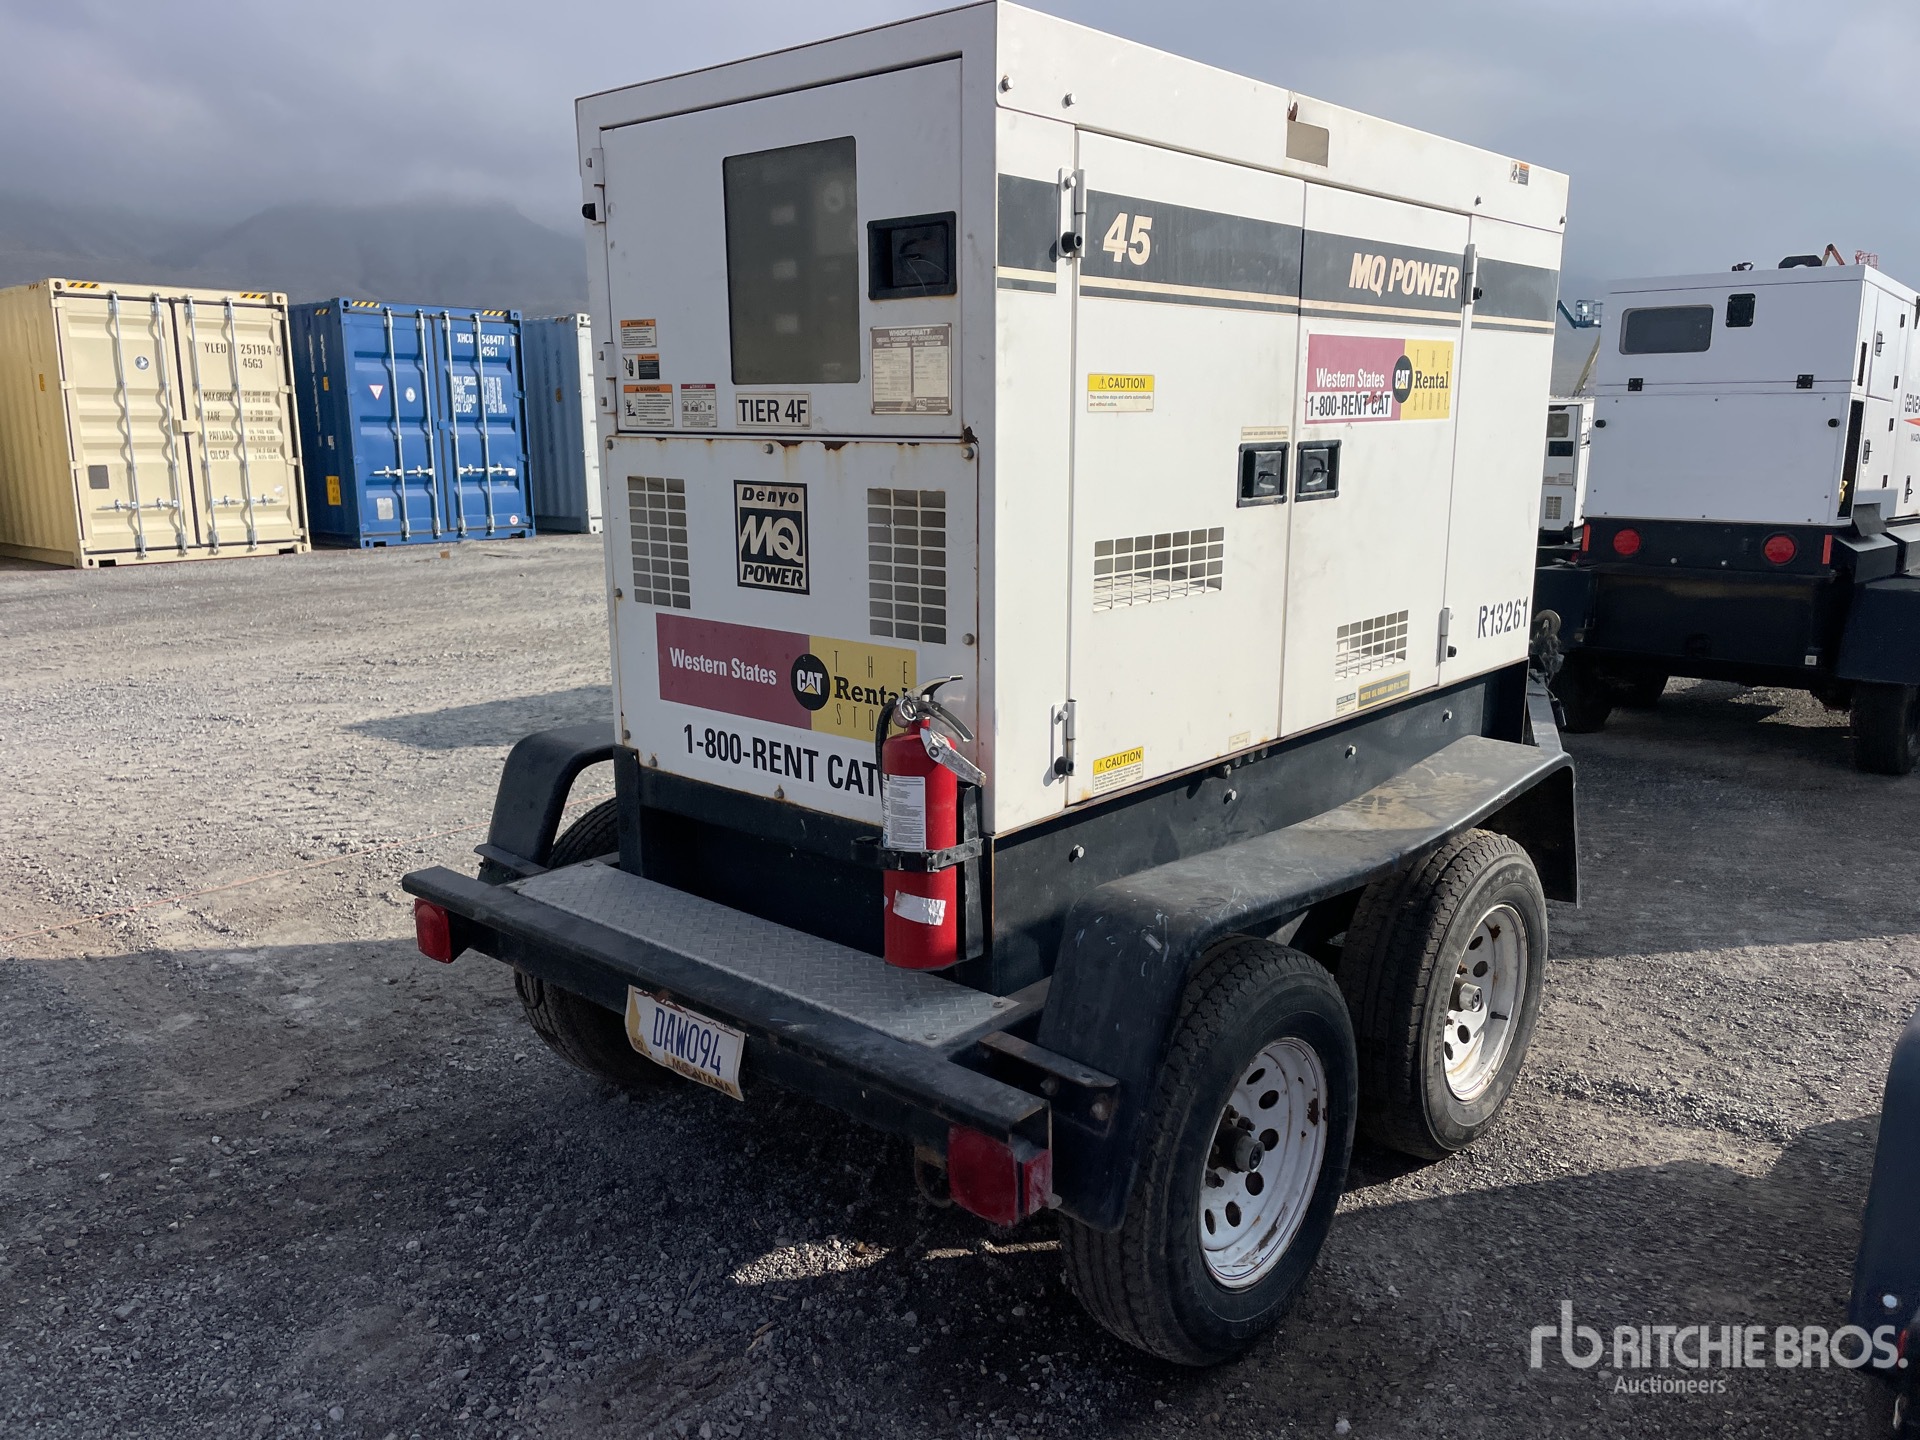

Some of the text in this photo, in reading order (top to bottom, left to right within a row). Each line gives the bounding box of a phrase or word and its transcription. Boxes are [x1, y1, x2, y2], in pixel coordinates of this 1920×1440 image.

[1103, 211, 1152, 265] 45
[1349, 252, 1459, 299] MQ POWER
[205, 343, 281, 356] YLEU 251194 9
[481, 334, 505, 345] 568477
[482, 346, 498, 357] 45G1
[243, 358, 263, 369] 45G3
[1108, 377, 1146, 389] CAUTION
[1316, 368, 1385, 388] Western States
[1395, 369, 1411, 389] CAT
[1414, 371, 1449, 389] Rental
[738, 399, 780, 422] TIER
[785, 399, 807, 423] 4F
[1309, 394, 1390, 416] 1-800-RENT CAT
[1905, 393, 1920, 413] GENE
[741, 487, 799, 507] Denyo
[740, 515, 804, 564] MQ
[742, 564, 803, 587] POWER
[1478, 596, 1528, 638] R13261
[670, 647, 777, 686] Western States
[834, 650, 908, 684] THE
[797, 669, 823, 695] CAT
[836, 703, 907, 735] STO
[684, 724, 877, 797] 1-800-RENT CAT
[1105, 750, 1141, 769] CAUTION
